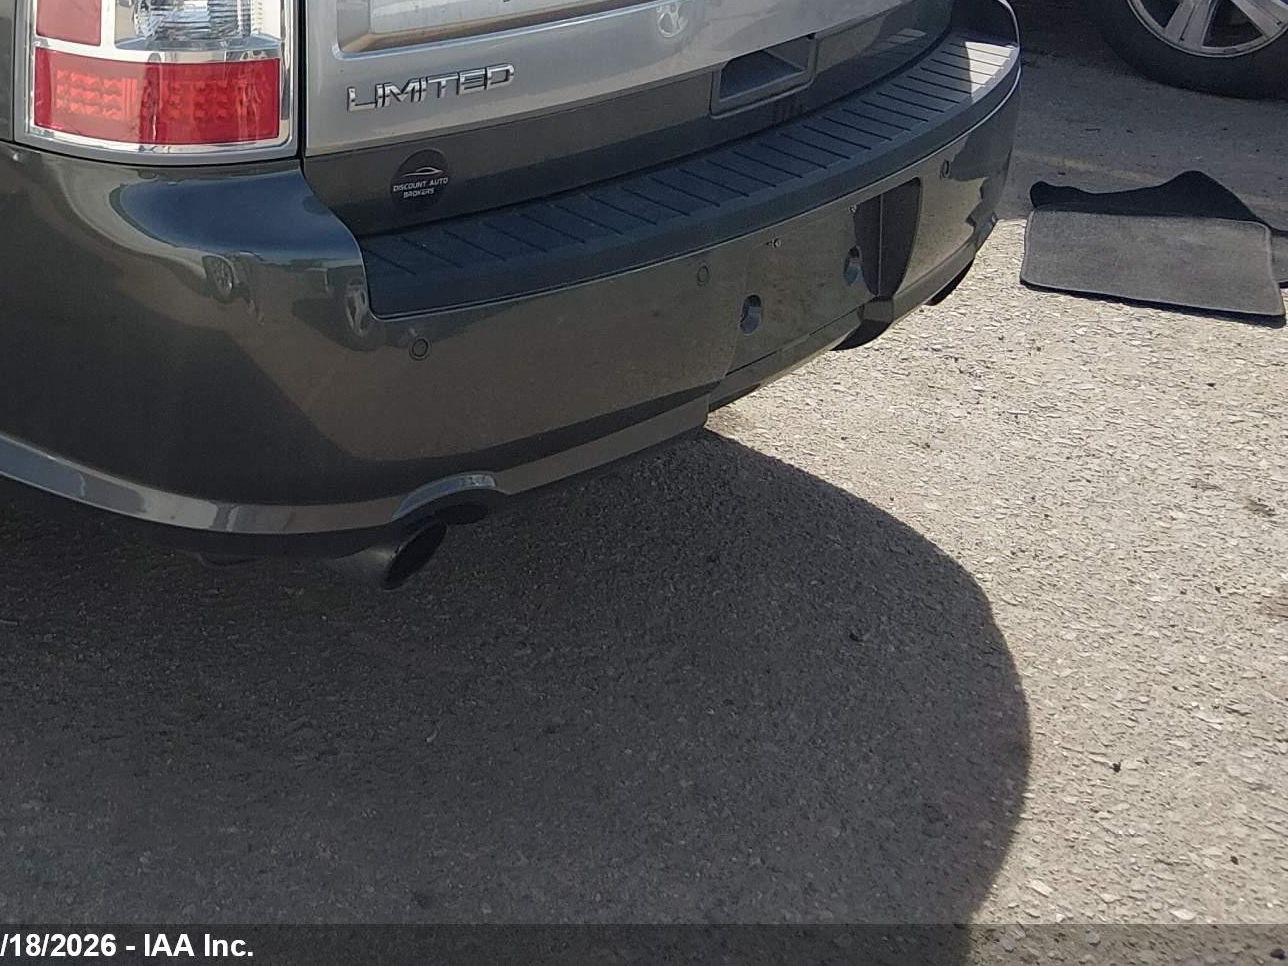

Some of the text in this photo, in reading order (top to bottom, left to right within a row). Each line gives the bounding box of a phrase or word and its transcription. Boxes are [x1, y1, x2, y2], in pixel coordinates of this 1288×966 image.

[346, 61, 515, 113] LIMITED
[393, 177, 448, 192] DISCOUNT AUTO
